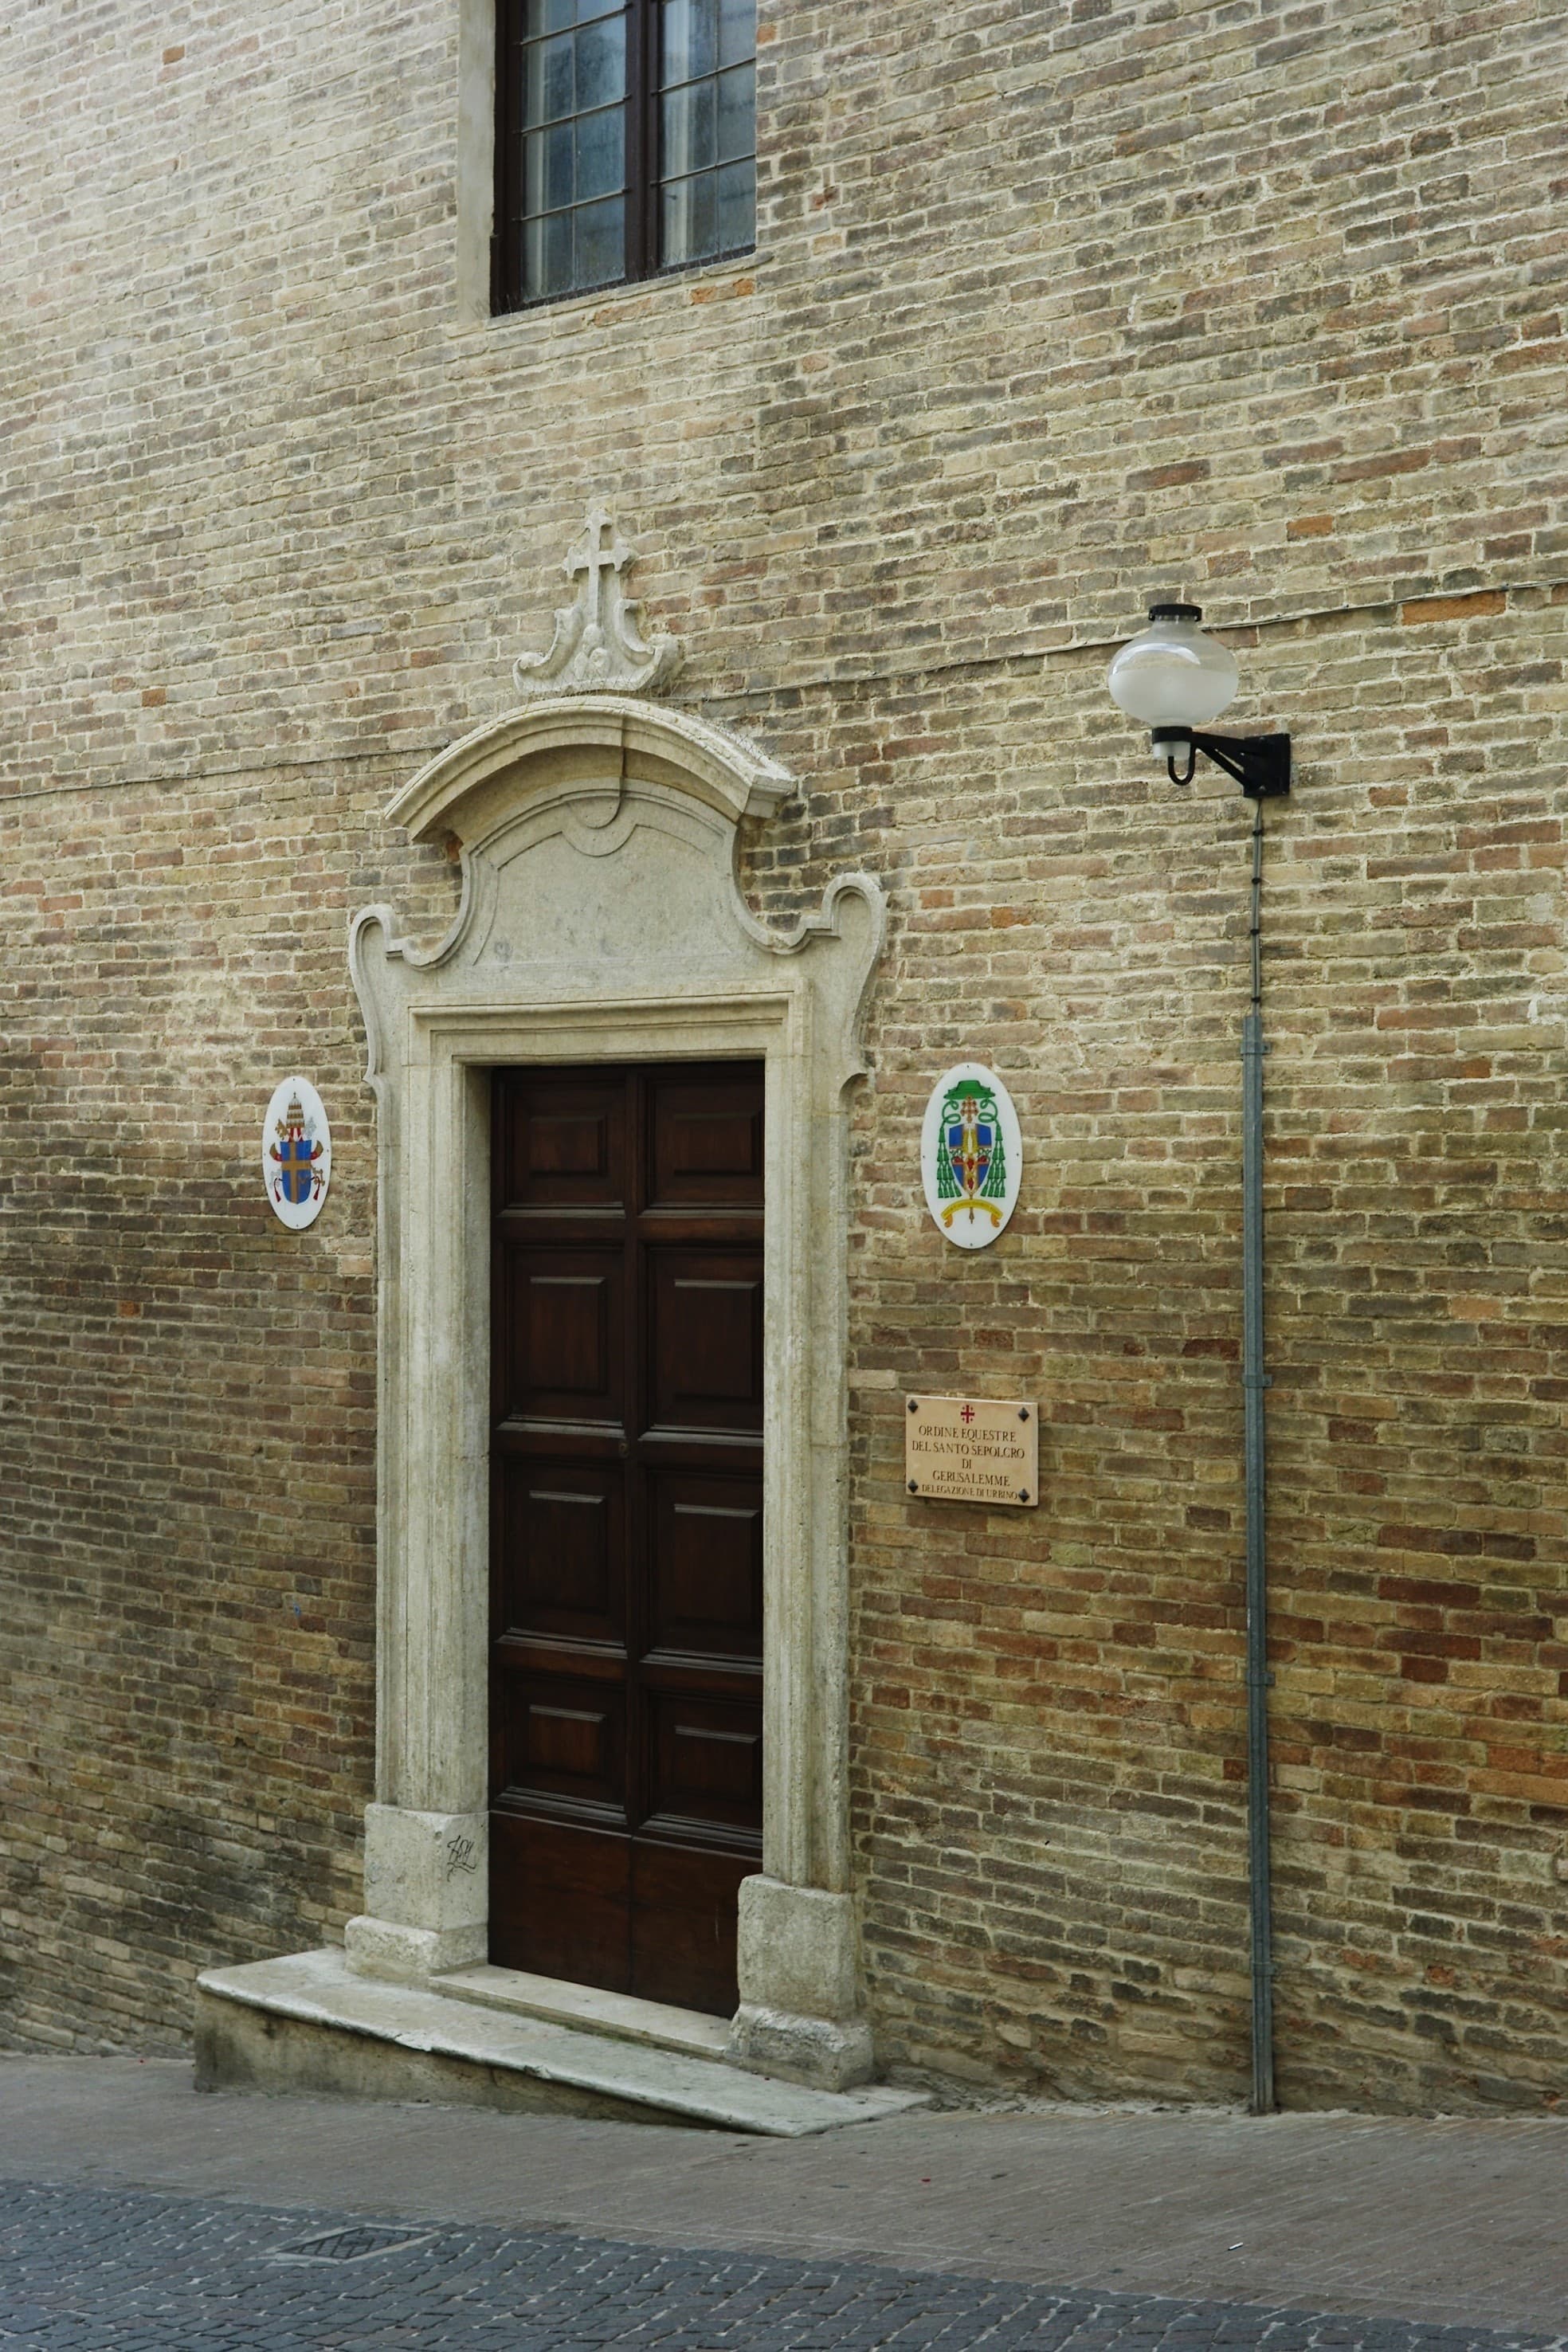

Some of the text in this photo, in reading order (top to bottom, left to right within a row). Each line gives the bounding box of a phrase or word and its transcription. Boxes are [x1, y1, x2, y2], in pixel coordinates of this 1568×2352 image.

[919, 1425, 1016, 1442] ORDINE EQUESTRE
[912, 1441, 1025, 1459] DEL SANTO SEPOLCRO
[962, 1459, 971, 1469] DI
[933, 1470, 1010, 1486] GERUSALEMME
[922, 1484, 974, 1496] DELEGAZIONE
[986, 1490, 1017, 1500] URBINO
